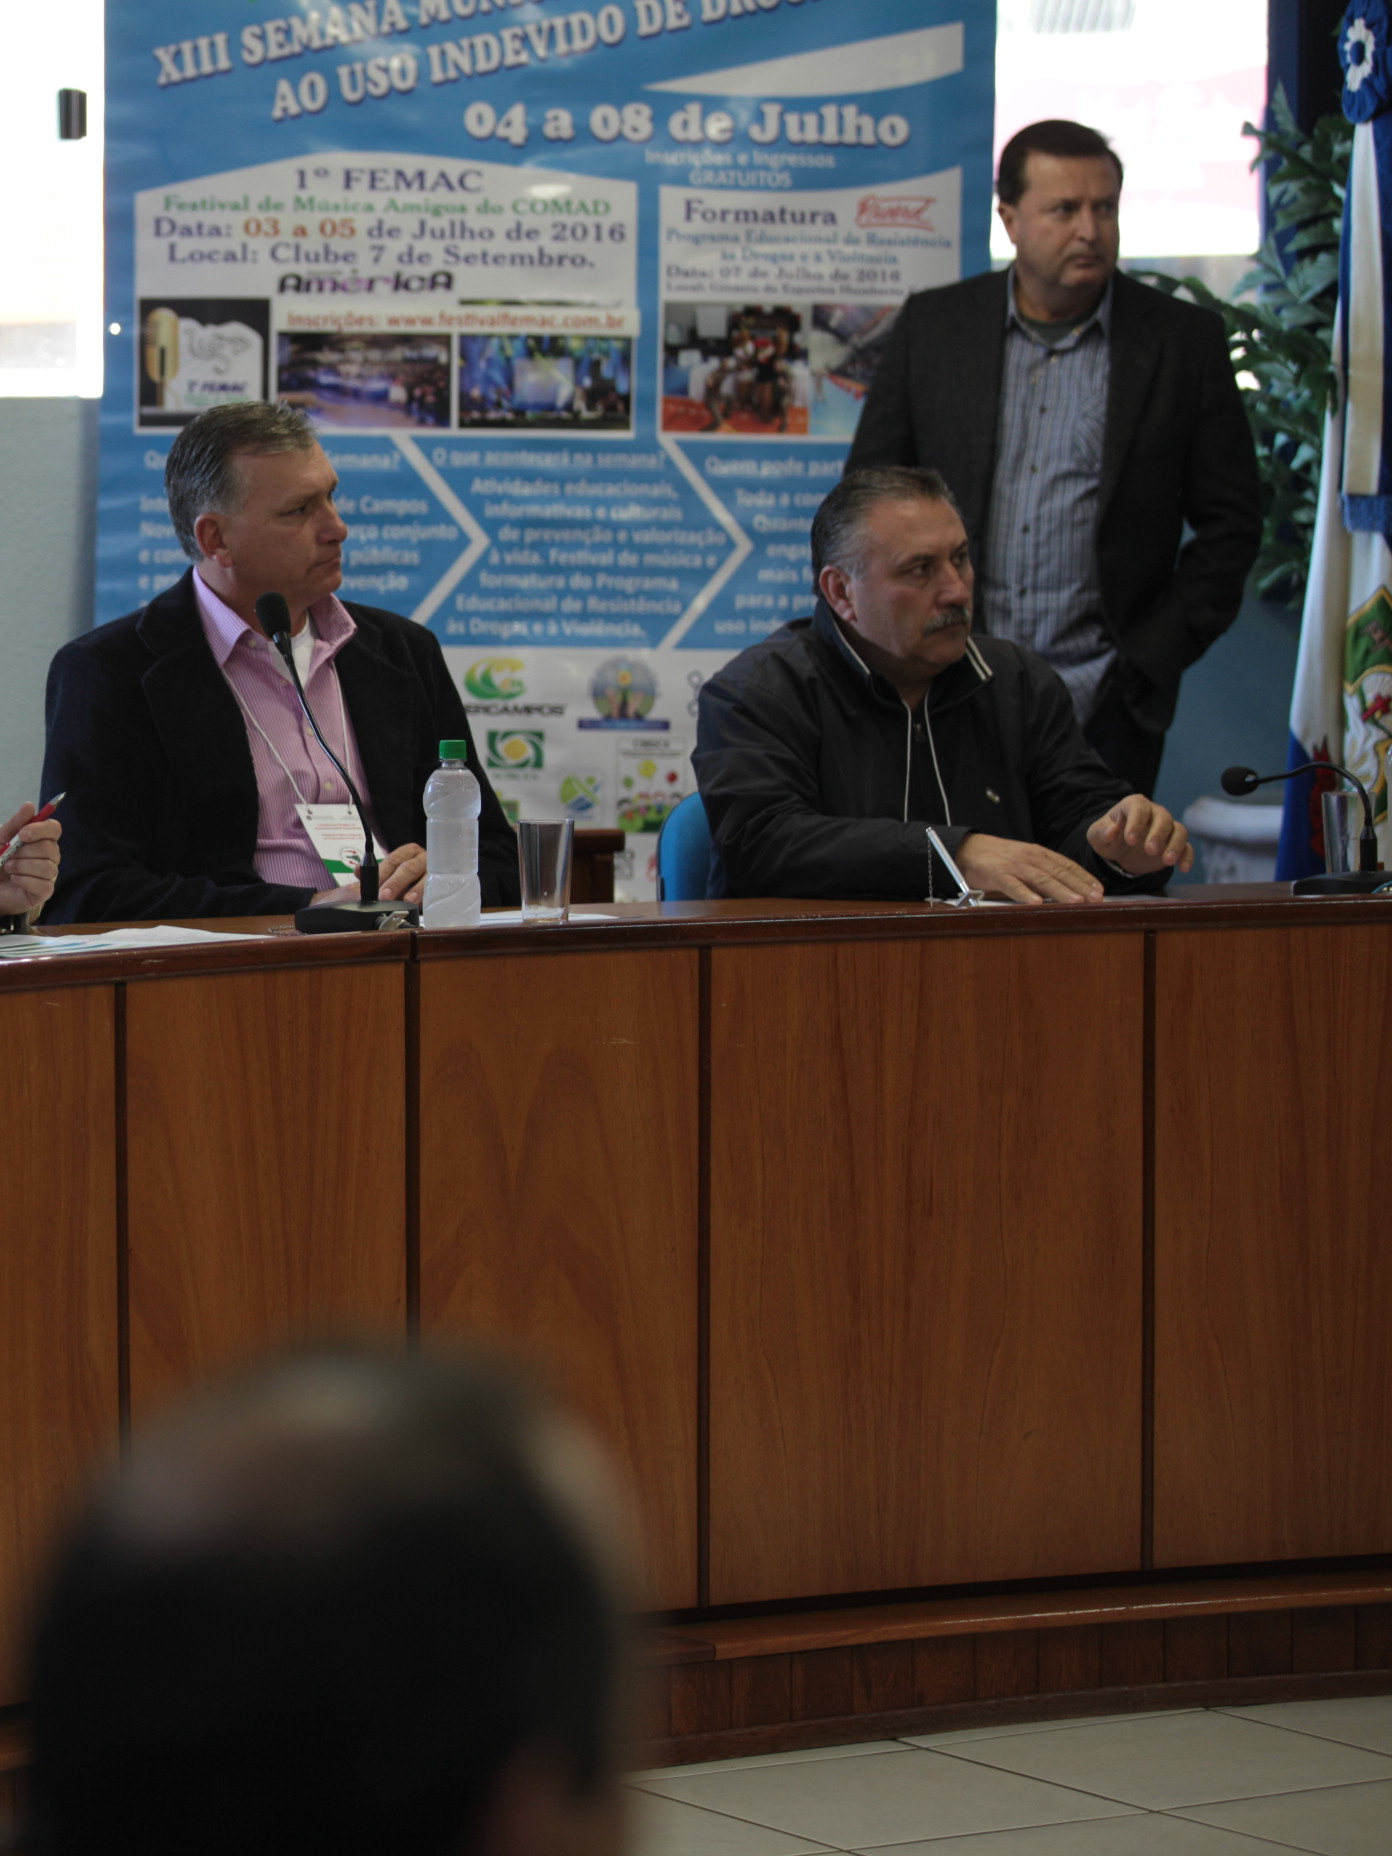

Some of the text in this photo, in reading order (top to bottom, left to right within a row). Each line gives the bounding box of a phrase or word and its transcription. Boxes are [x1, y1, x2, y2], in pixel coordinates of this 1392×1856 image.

[154, 32, 233, 86] XIII
[241, 0, 411, 65] SEMANA
[271, 71, 328, 121] AO
[337, 51, 419, 104] USO
[426, 4, 626, 85] INDEVIDO
[633, 0, 692, 38] DE
[464, 101, 910, 148] 04 a 08 de Julho
[645, 148, 836, 169] Inscrições e Ingressos
[342, 167, 484, 193] FEMAC
[689, 169, 793, 188] GRATUITOS
[163, 194, 613, 218] Festival de Música Amigos do COMAD
[684, 198, 838, 227] Formatura
[153, 216, 627, 244] Data: 03 a 05 de Julho de 2016
[168, 242, 596, 269] Local: Clube 7 de Setembro.
[433, 449, 448, 467] O
[471, 477, 562, 497] Atividades
[360, 495, 429, 519] Campos
[485, 498, 683, 522] informativas e culturais
[498, 524, 520, 542] de
[549, 548, 614, 568] Festival
[617, 550, 640, 568] de
[479, 570, 679, 595] formatura do Programa
[456, 594, 557, 614] Educacional
[560, 594, 584, 615] de
